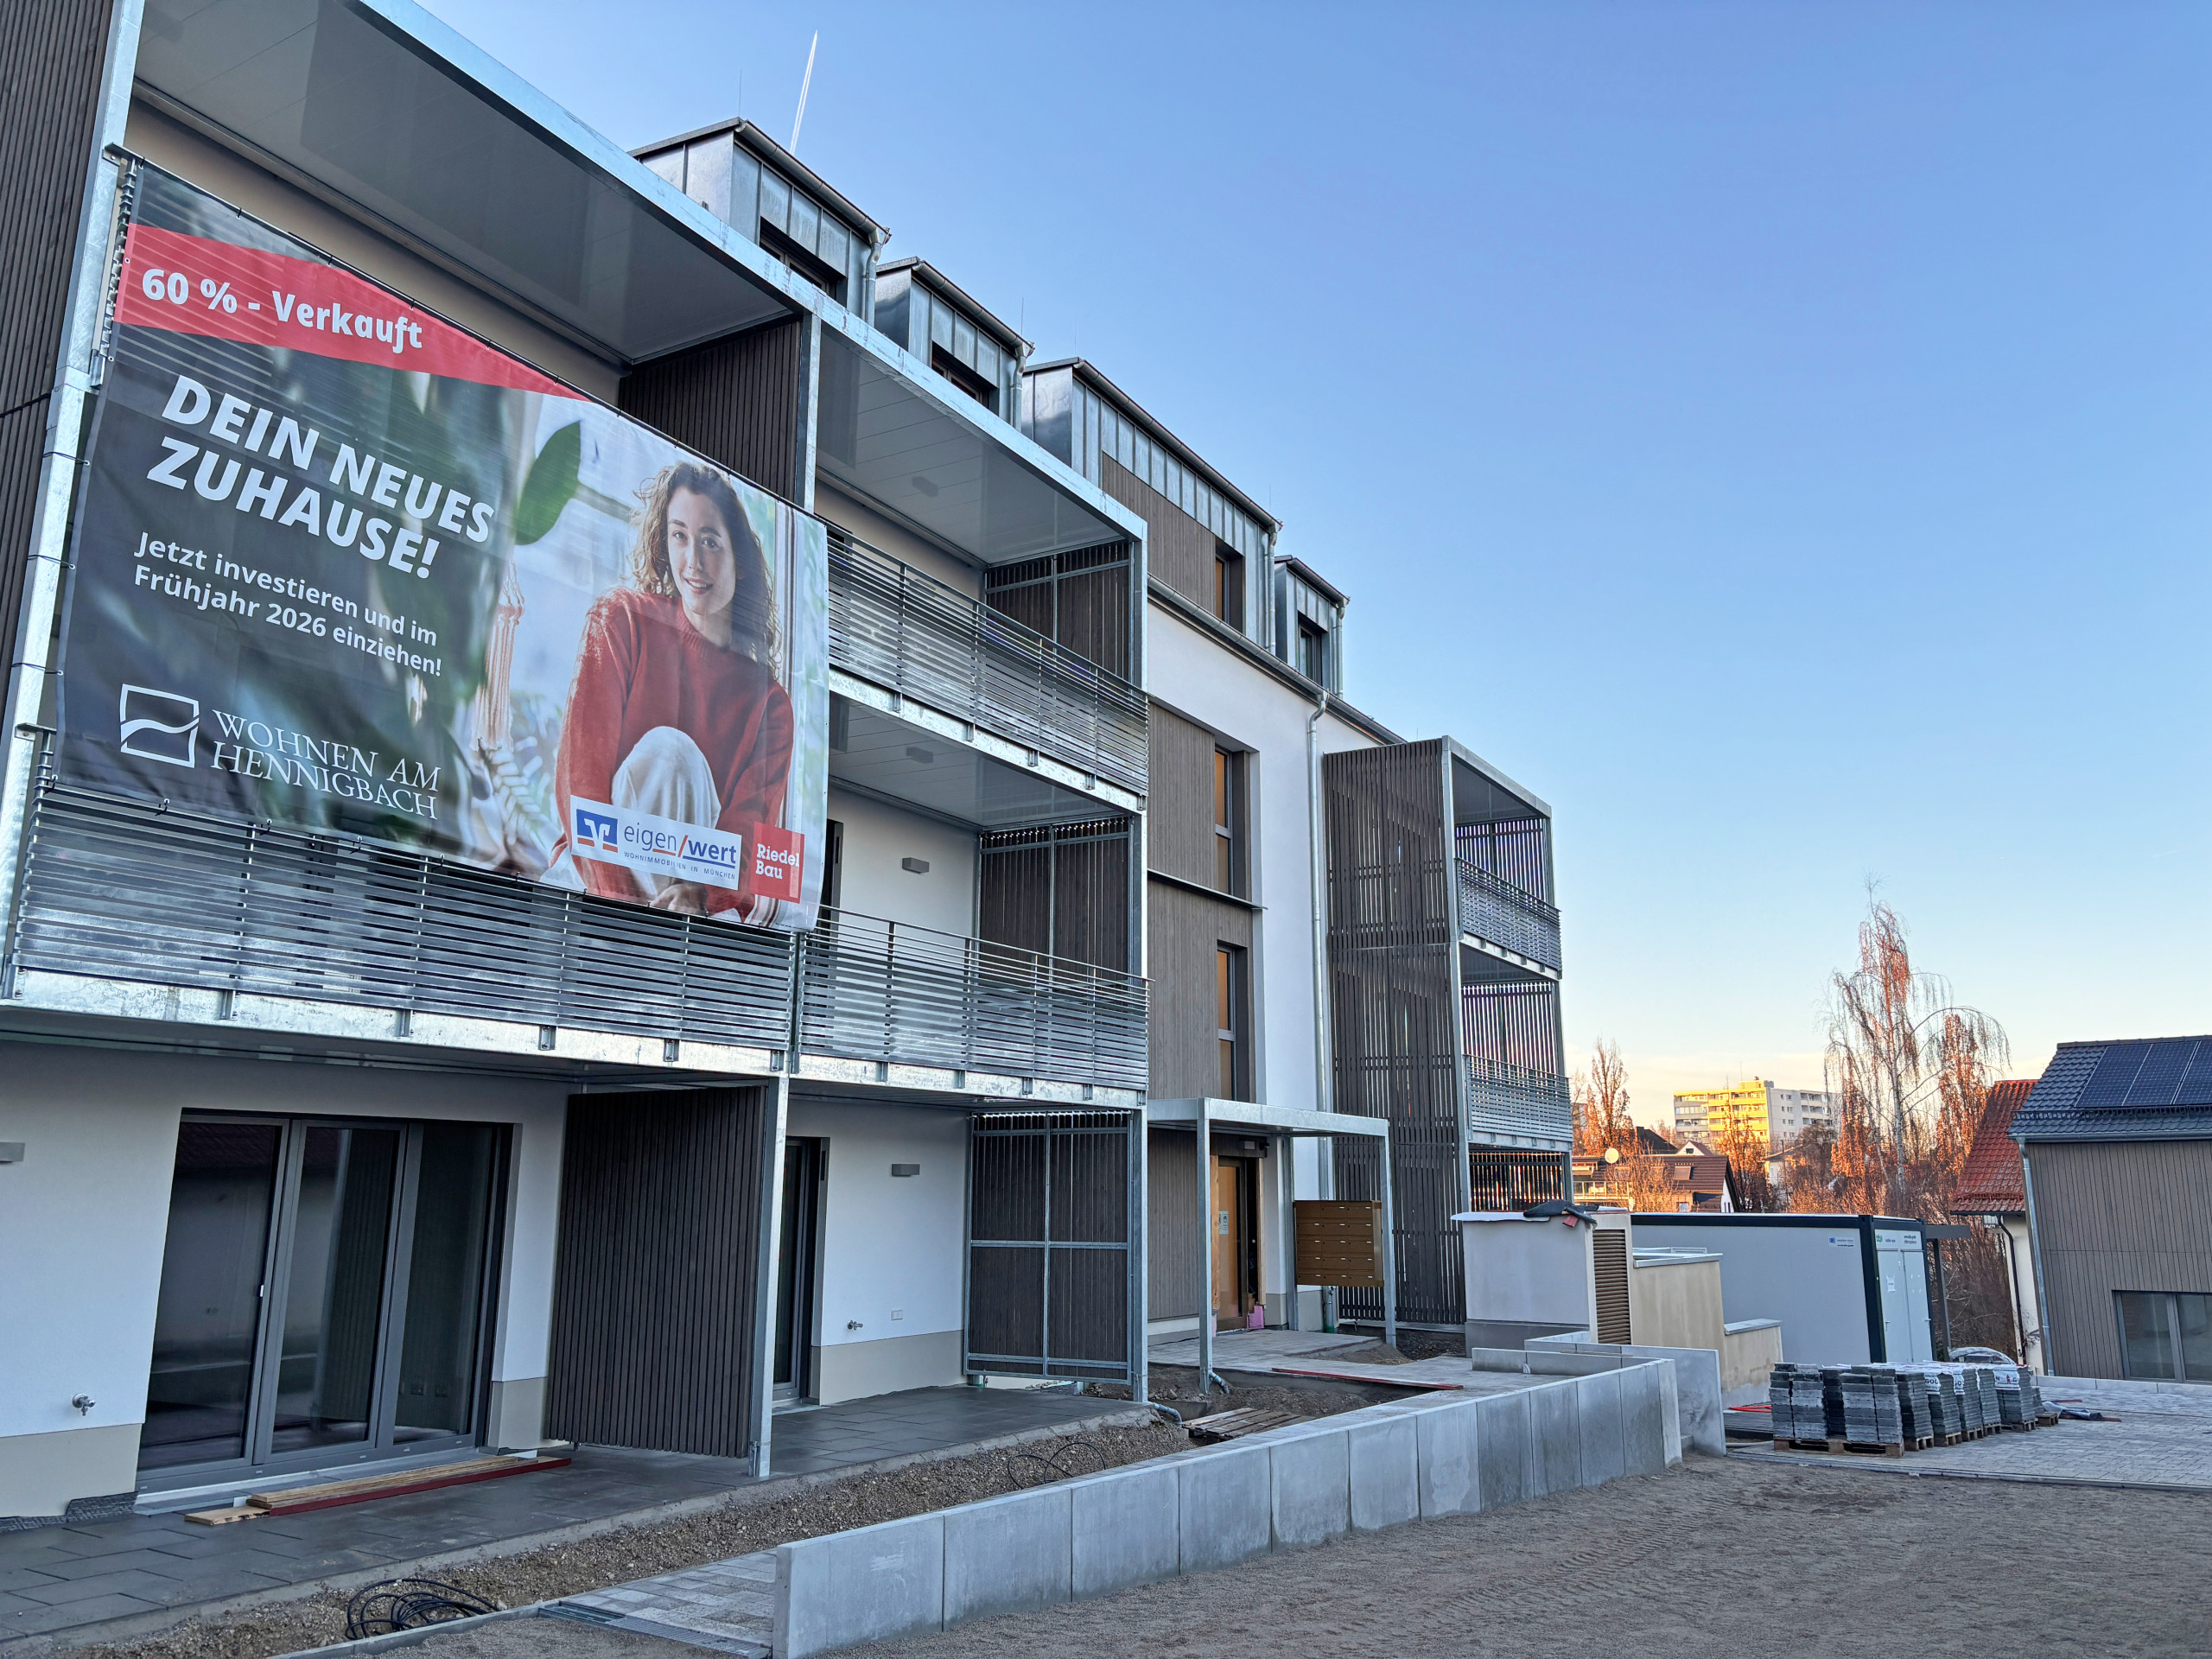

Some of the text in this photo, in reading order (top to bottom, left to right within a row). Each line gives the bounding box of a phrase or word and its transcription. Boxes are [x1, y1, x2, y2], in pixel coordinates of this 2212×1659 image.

[142, 269, 189, 304] 60
[200, 278, 238, 314] %
[273, 291, 423, 353] Verkauft
[162, 375, 495, 543] DEIN NEUES
[146, 436, 441, 579] ZUHAUSE!
[134, 532, 437, 646] Jetzt investieren und im
[135, 565, 442, 677] Frühjahr 2026 einziehen!
[211, 741, 436, 820] HENNIGBACH
[213, 709, 442, 791] WOHNEN AM
[624, 822, 737, 864] eigen/wert
[624, 851, 686, 870] WOHNIMMOBILIEN
[703, 868, 736, 880] MÜNCHEN
[756, 860, 783, 880] Bau
[757, 843, 800, 868] Riedel
